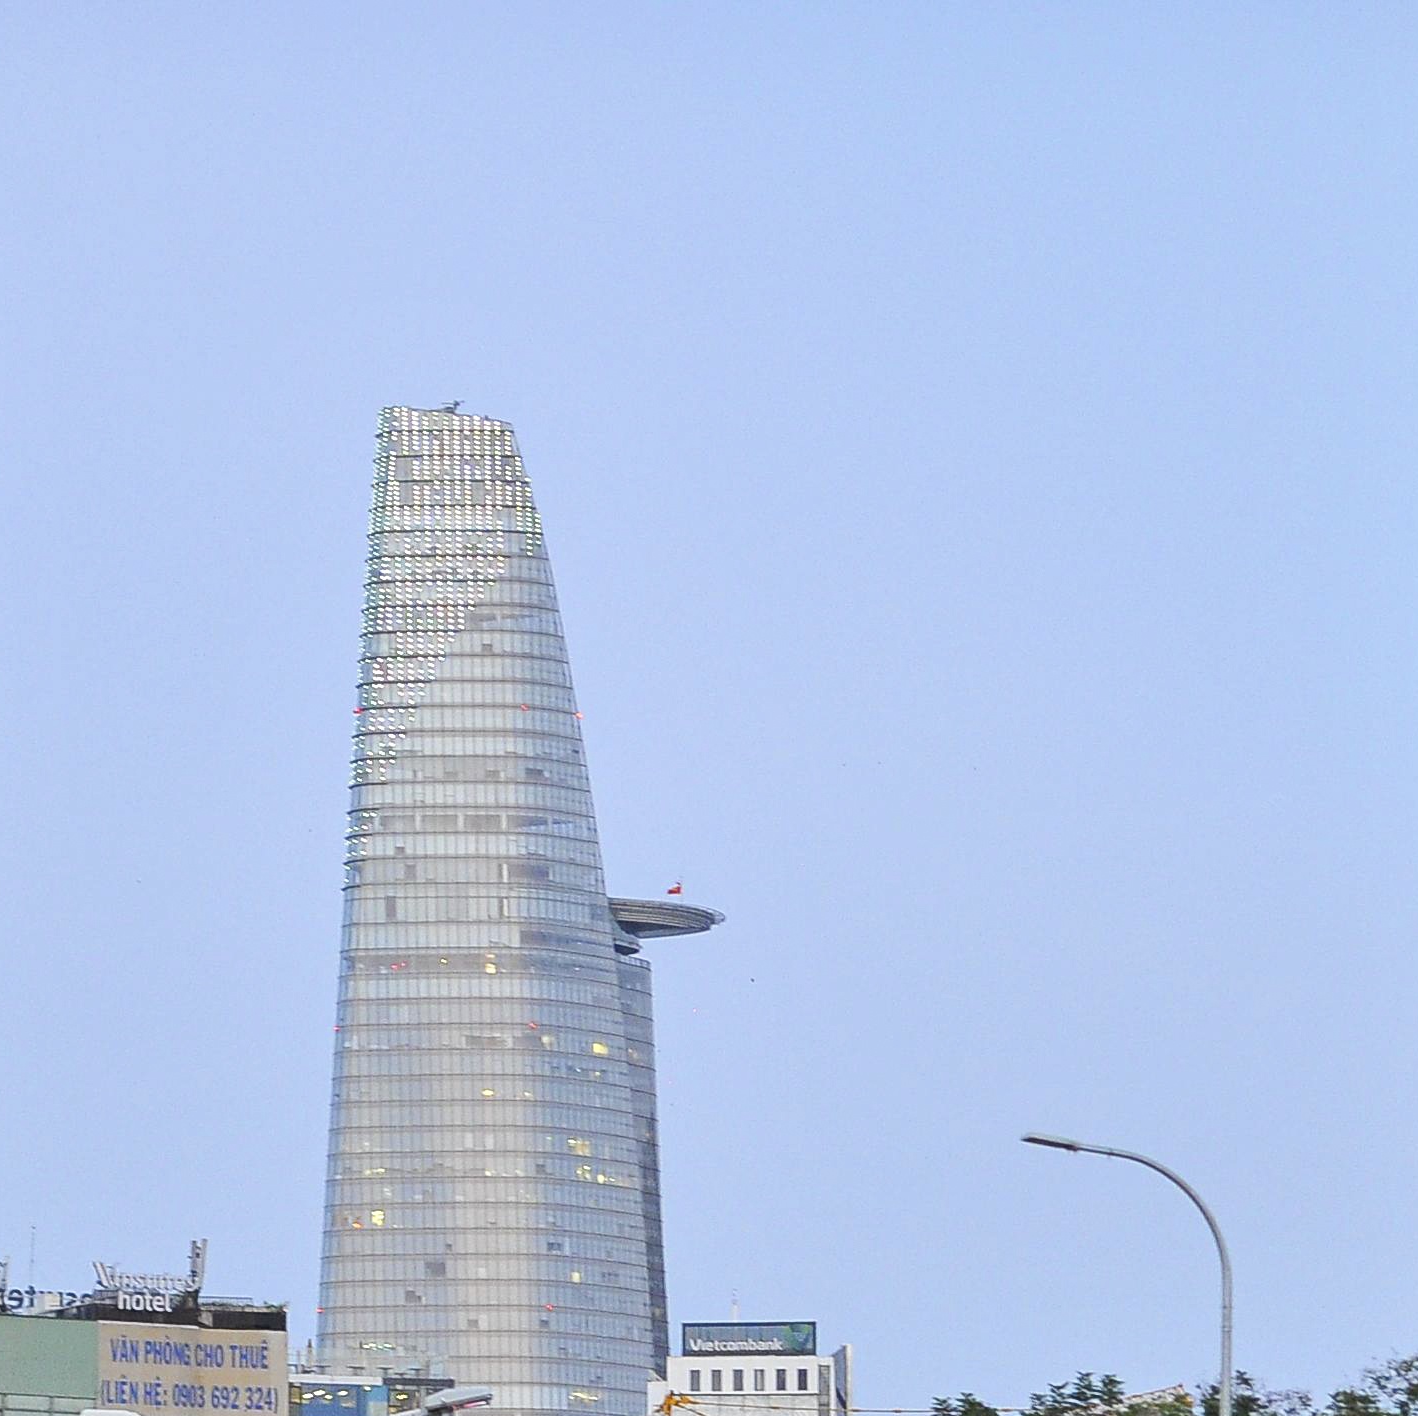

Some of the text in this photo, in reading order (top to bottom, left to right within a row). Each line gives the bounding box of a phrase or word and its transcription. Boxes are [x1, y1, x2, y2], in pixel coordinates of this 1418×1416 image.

[117, 1289, 173, 1313] hotel
[144, 1335, 192, 1367] PHÒNG
[194, 1343, 224, 1368] CHO
[229, 1340, 269, 1369] THUÊ
[689, 1338, 783, 1351] Vietcombank
[172, 1383, 205, 1408] 0903
[211, 1385, 240, 1410] 692
